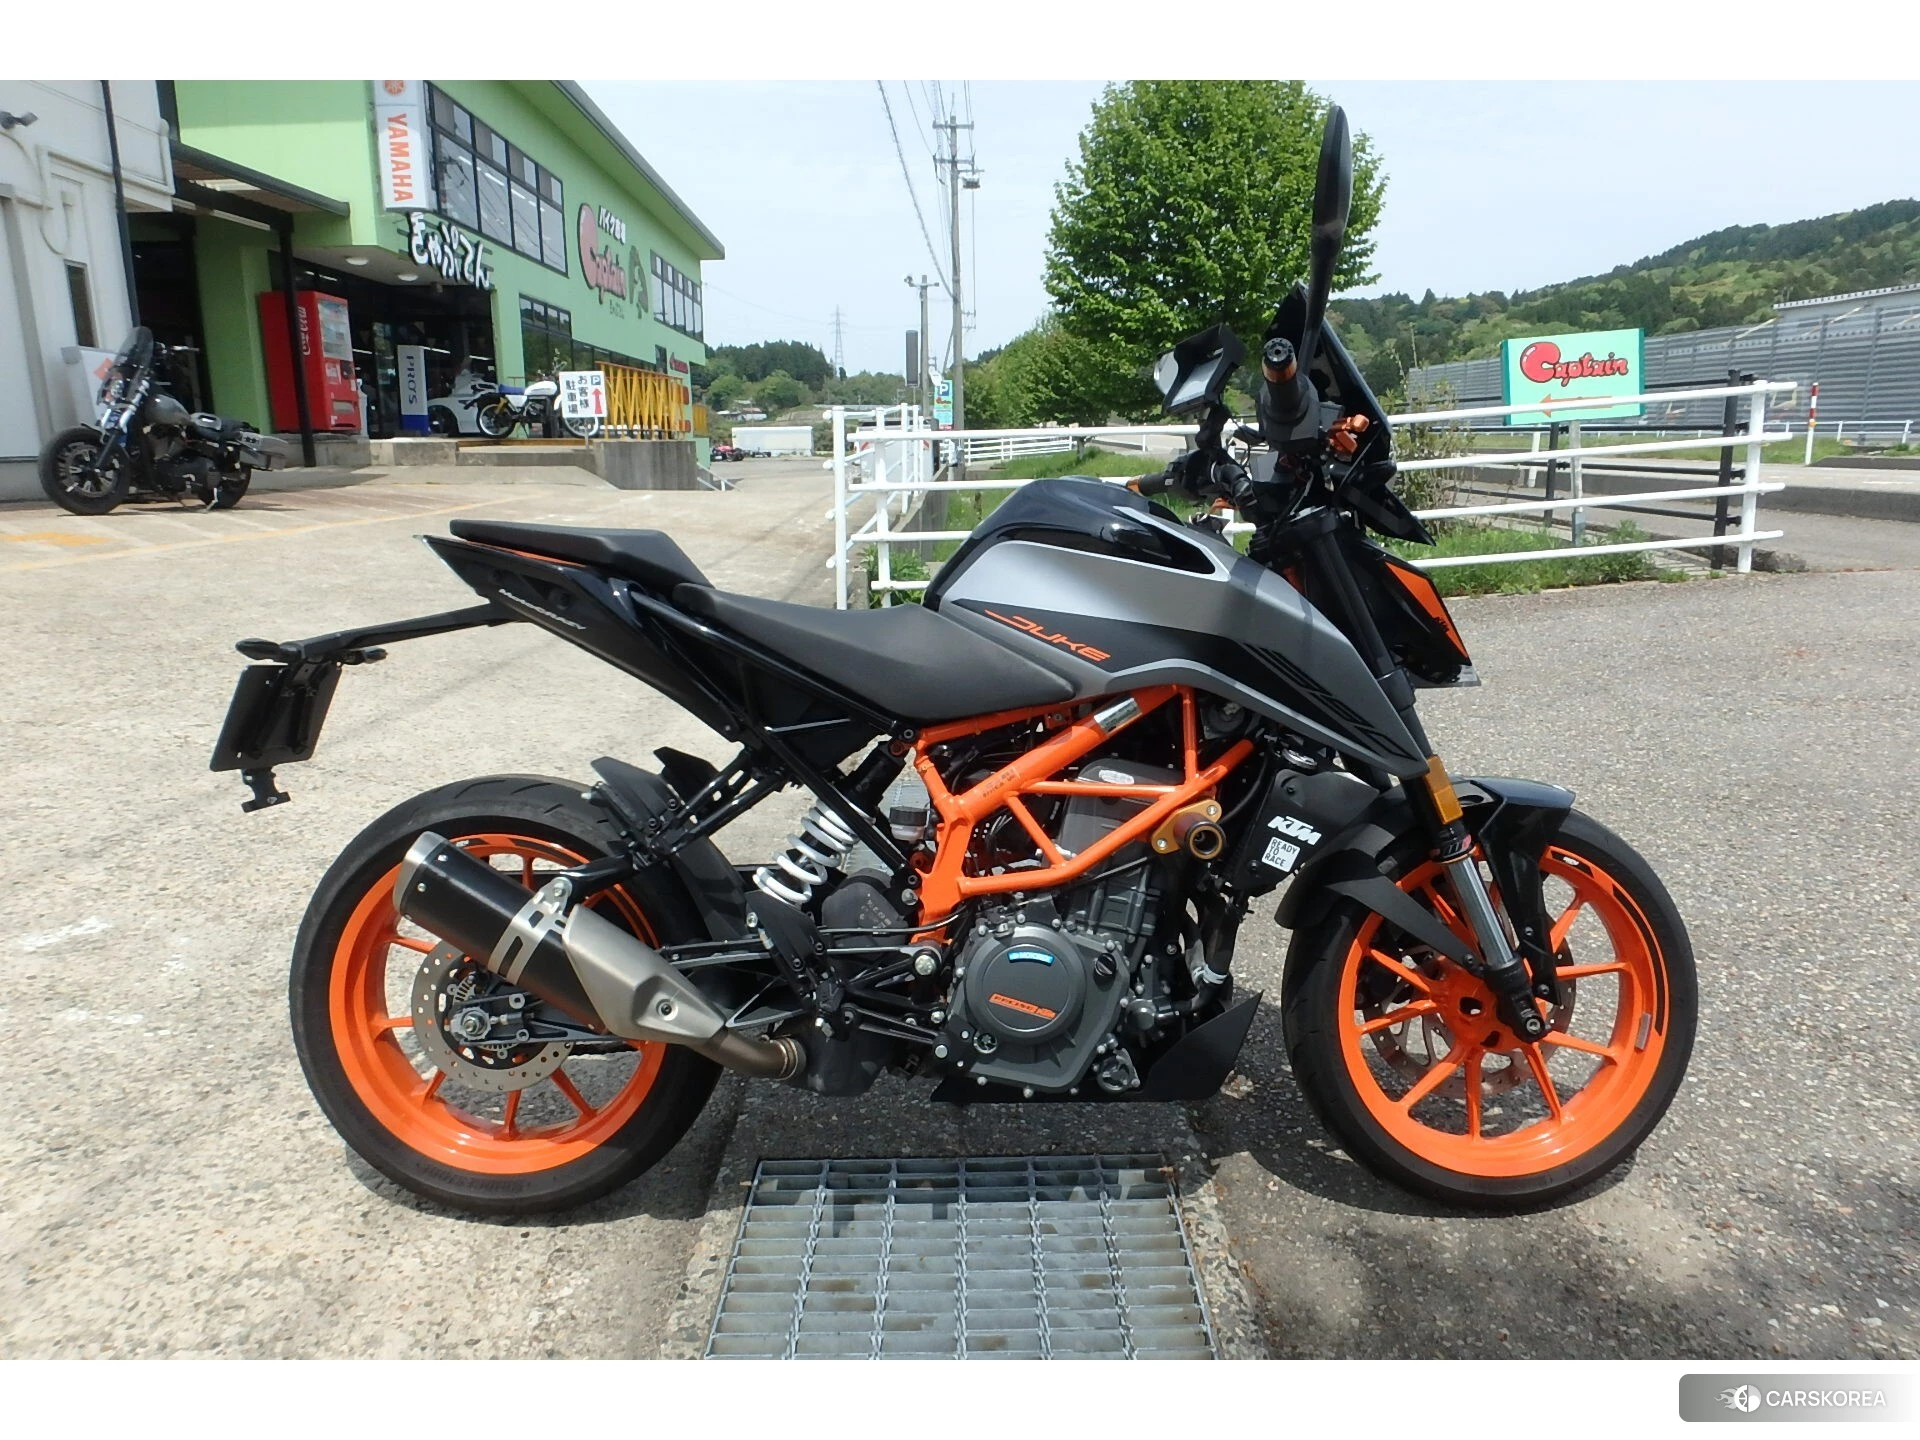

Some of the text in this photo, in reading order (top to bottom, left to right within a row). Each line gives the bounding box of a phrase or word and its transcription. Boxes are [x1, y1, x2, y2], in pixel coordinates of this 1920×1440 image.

[387, 113, 414, 202] YAMAHA
[409, 211, 491, 290] きゃぷてん
[1519, 341, 1629, 388] Captain
[566, 379, 579, 414] 駐車場
[578, 375, 590, 409] お客様
[984, 609, 1112, 662] DUKE
[1267, 815, 1322, 846] KTM
[1271, 839, 1298, 855] READY
[1264, 852, 1287, 867] RACE
[1269, 846, 1280, 856] TO
